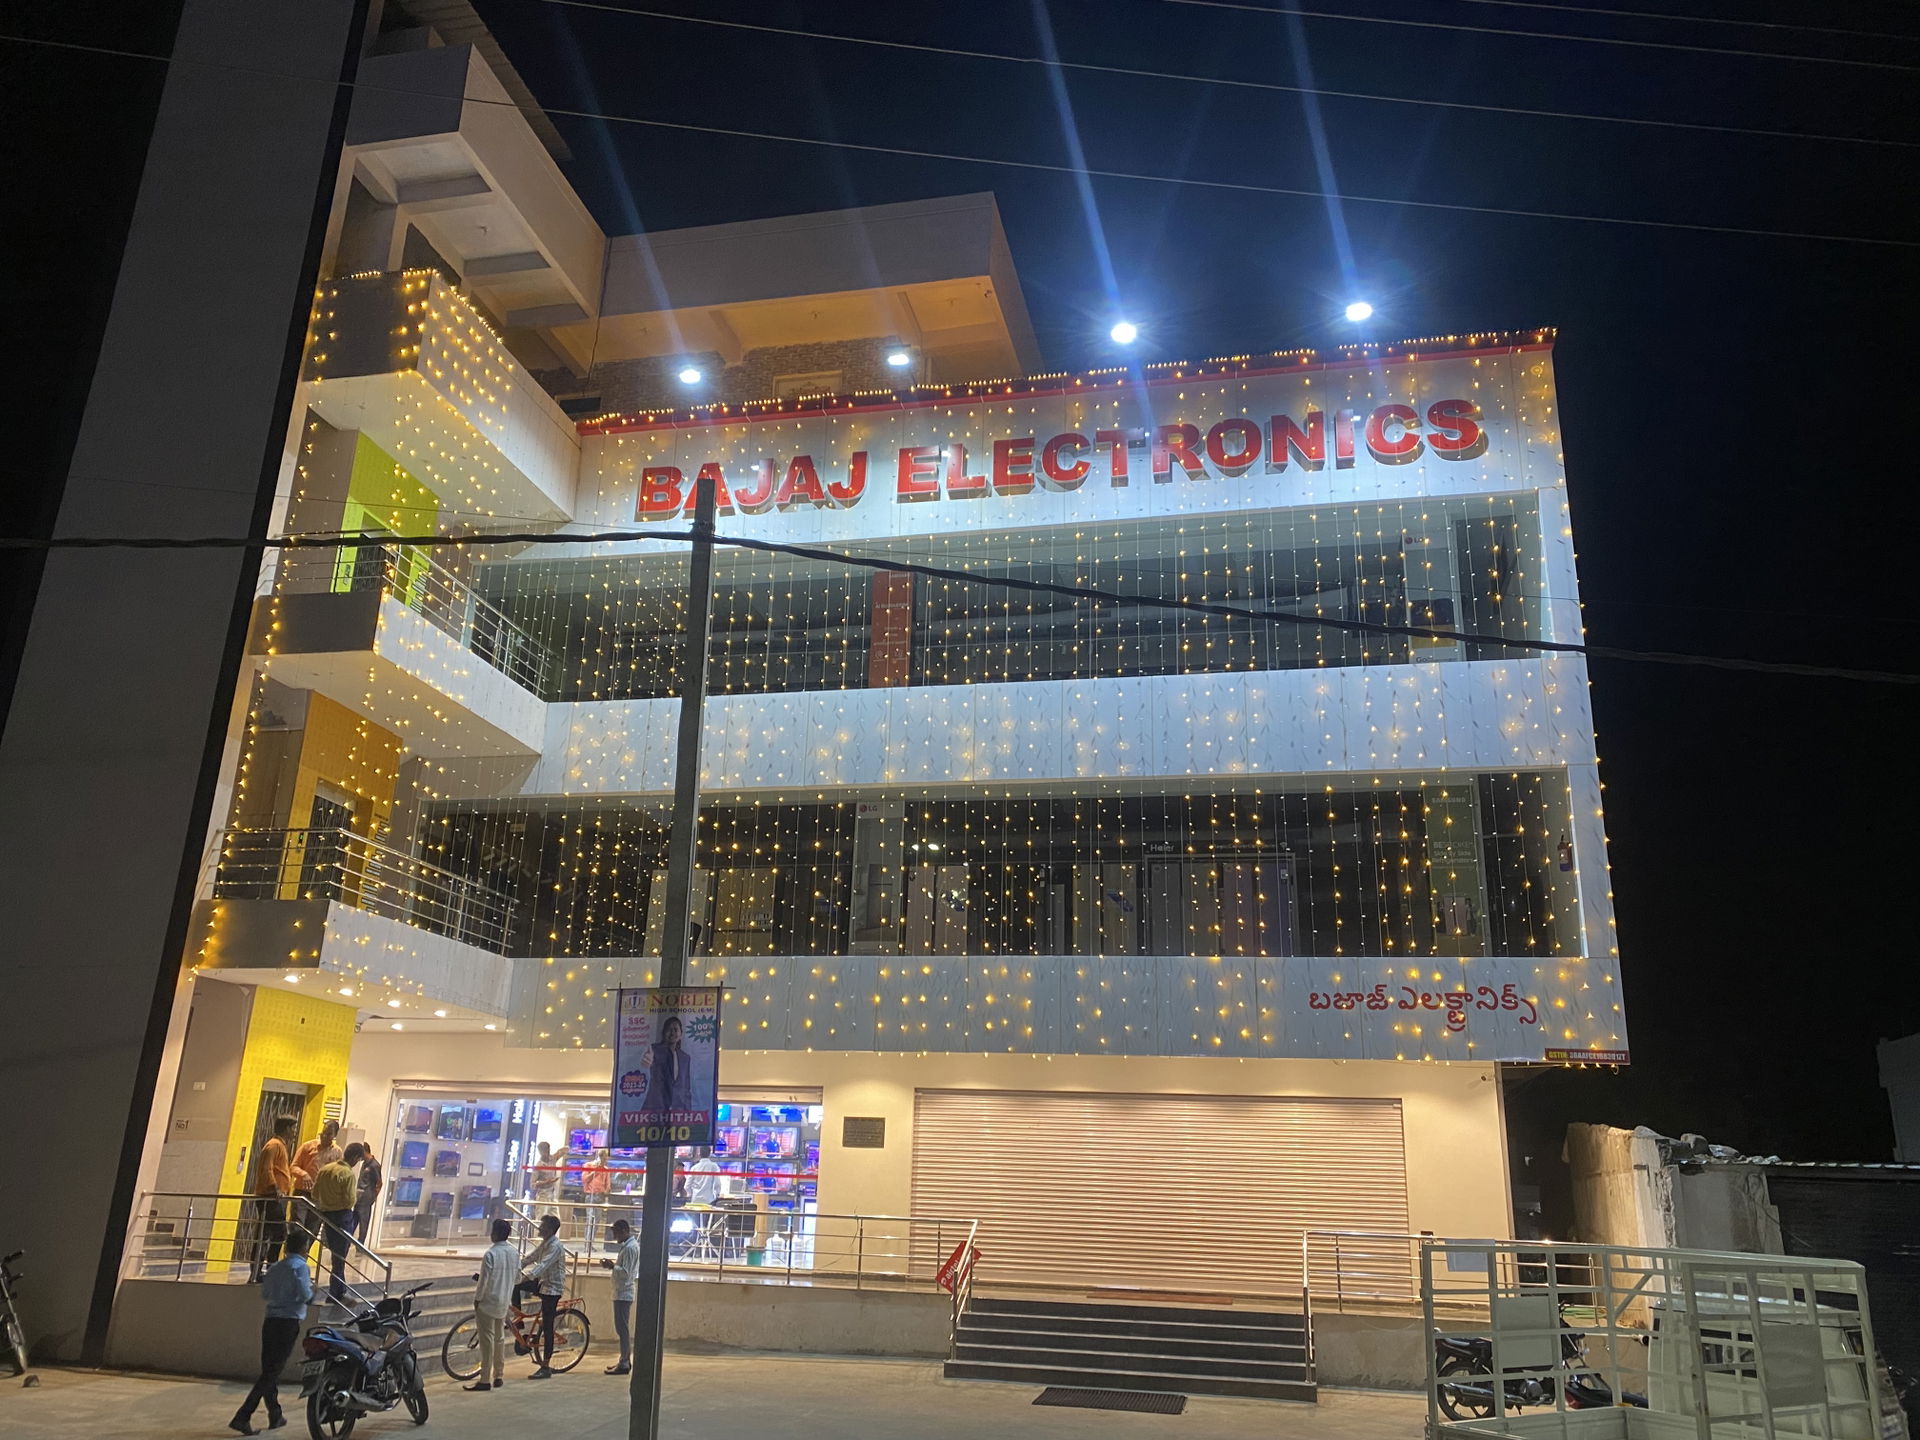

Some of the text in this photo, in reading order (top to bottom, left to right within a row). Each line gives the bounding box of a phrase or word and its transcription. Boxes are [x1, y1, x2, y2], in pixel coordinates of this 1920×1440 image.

[637, 399, 1486, 519] BAJAJ ELECTRONICS
[651, 993, 715, 1007] NOBLE
[628, 1016, 645, 1024] SSC
[624, 1112, 703, 1123] VIKSHITHA
[636, 1126, 690, 1142] 10/10
